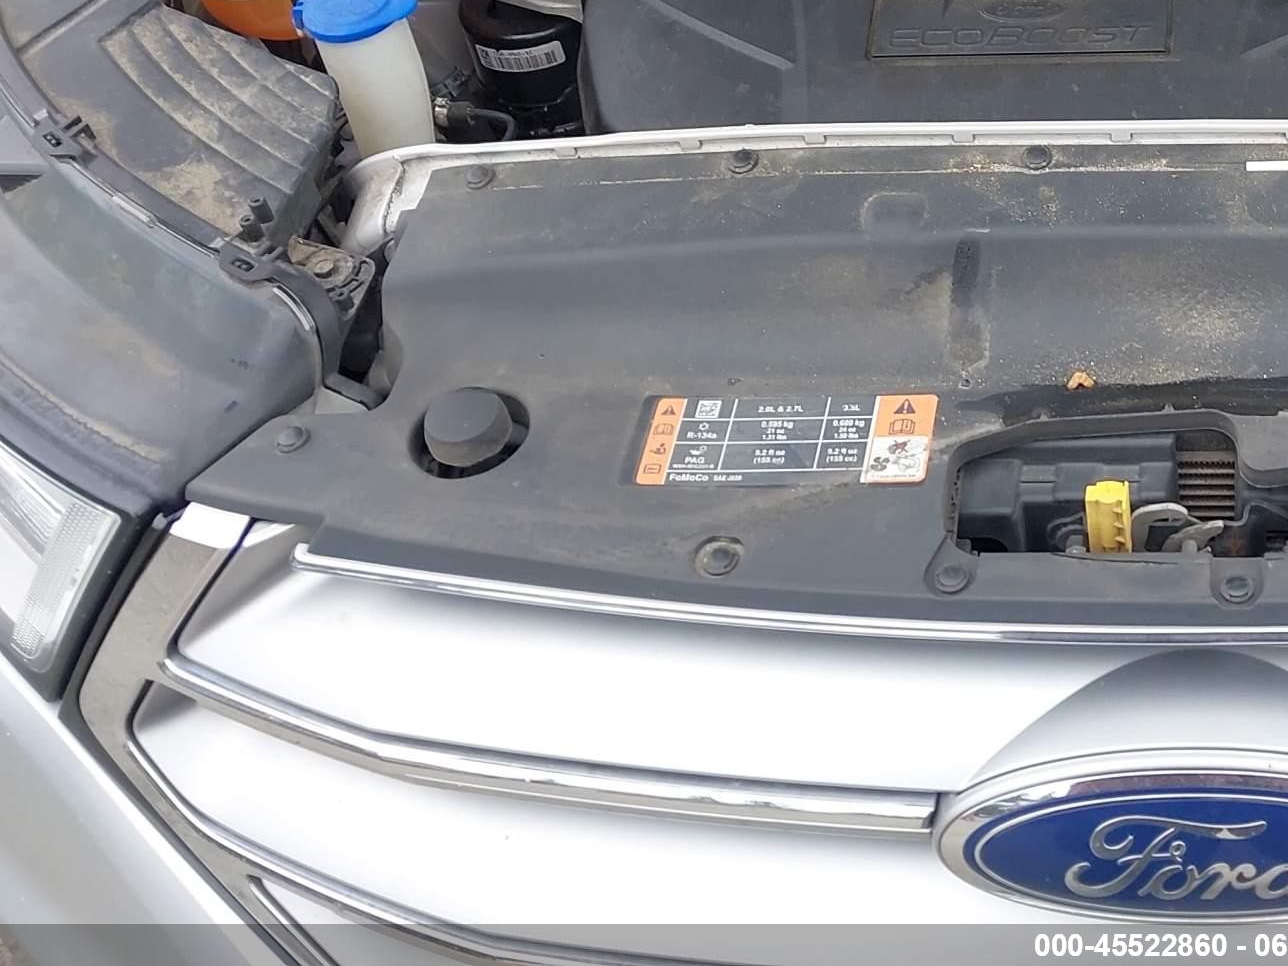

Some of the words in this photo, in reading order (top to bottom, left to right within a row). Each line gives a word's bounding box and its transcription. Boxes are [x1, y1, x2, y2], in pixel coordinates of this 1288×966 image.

[888, 26, 1152, 49] ECOBOOST
[686, 431, 718, 440] R-134a
[684, 456, 706, 464] PAG
[669, 473, 709, 482] FoMoCo
